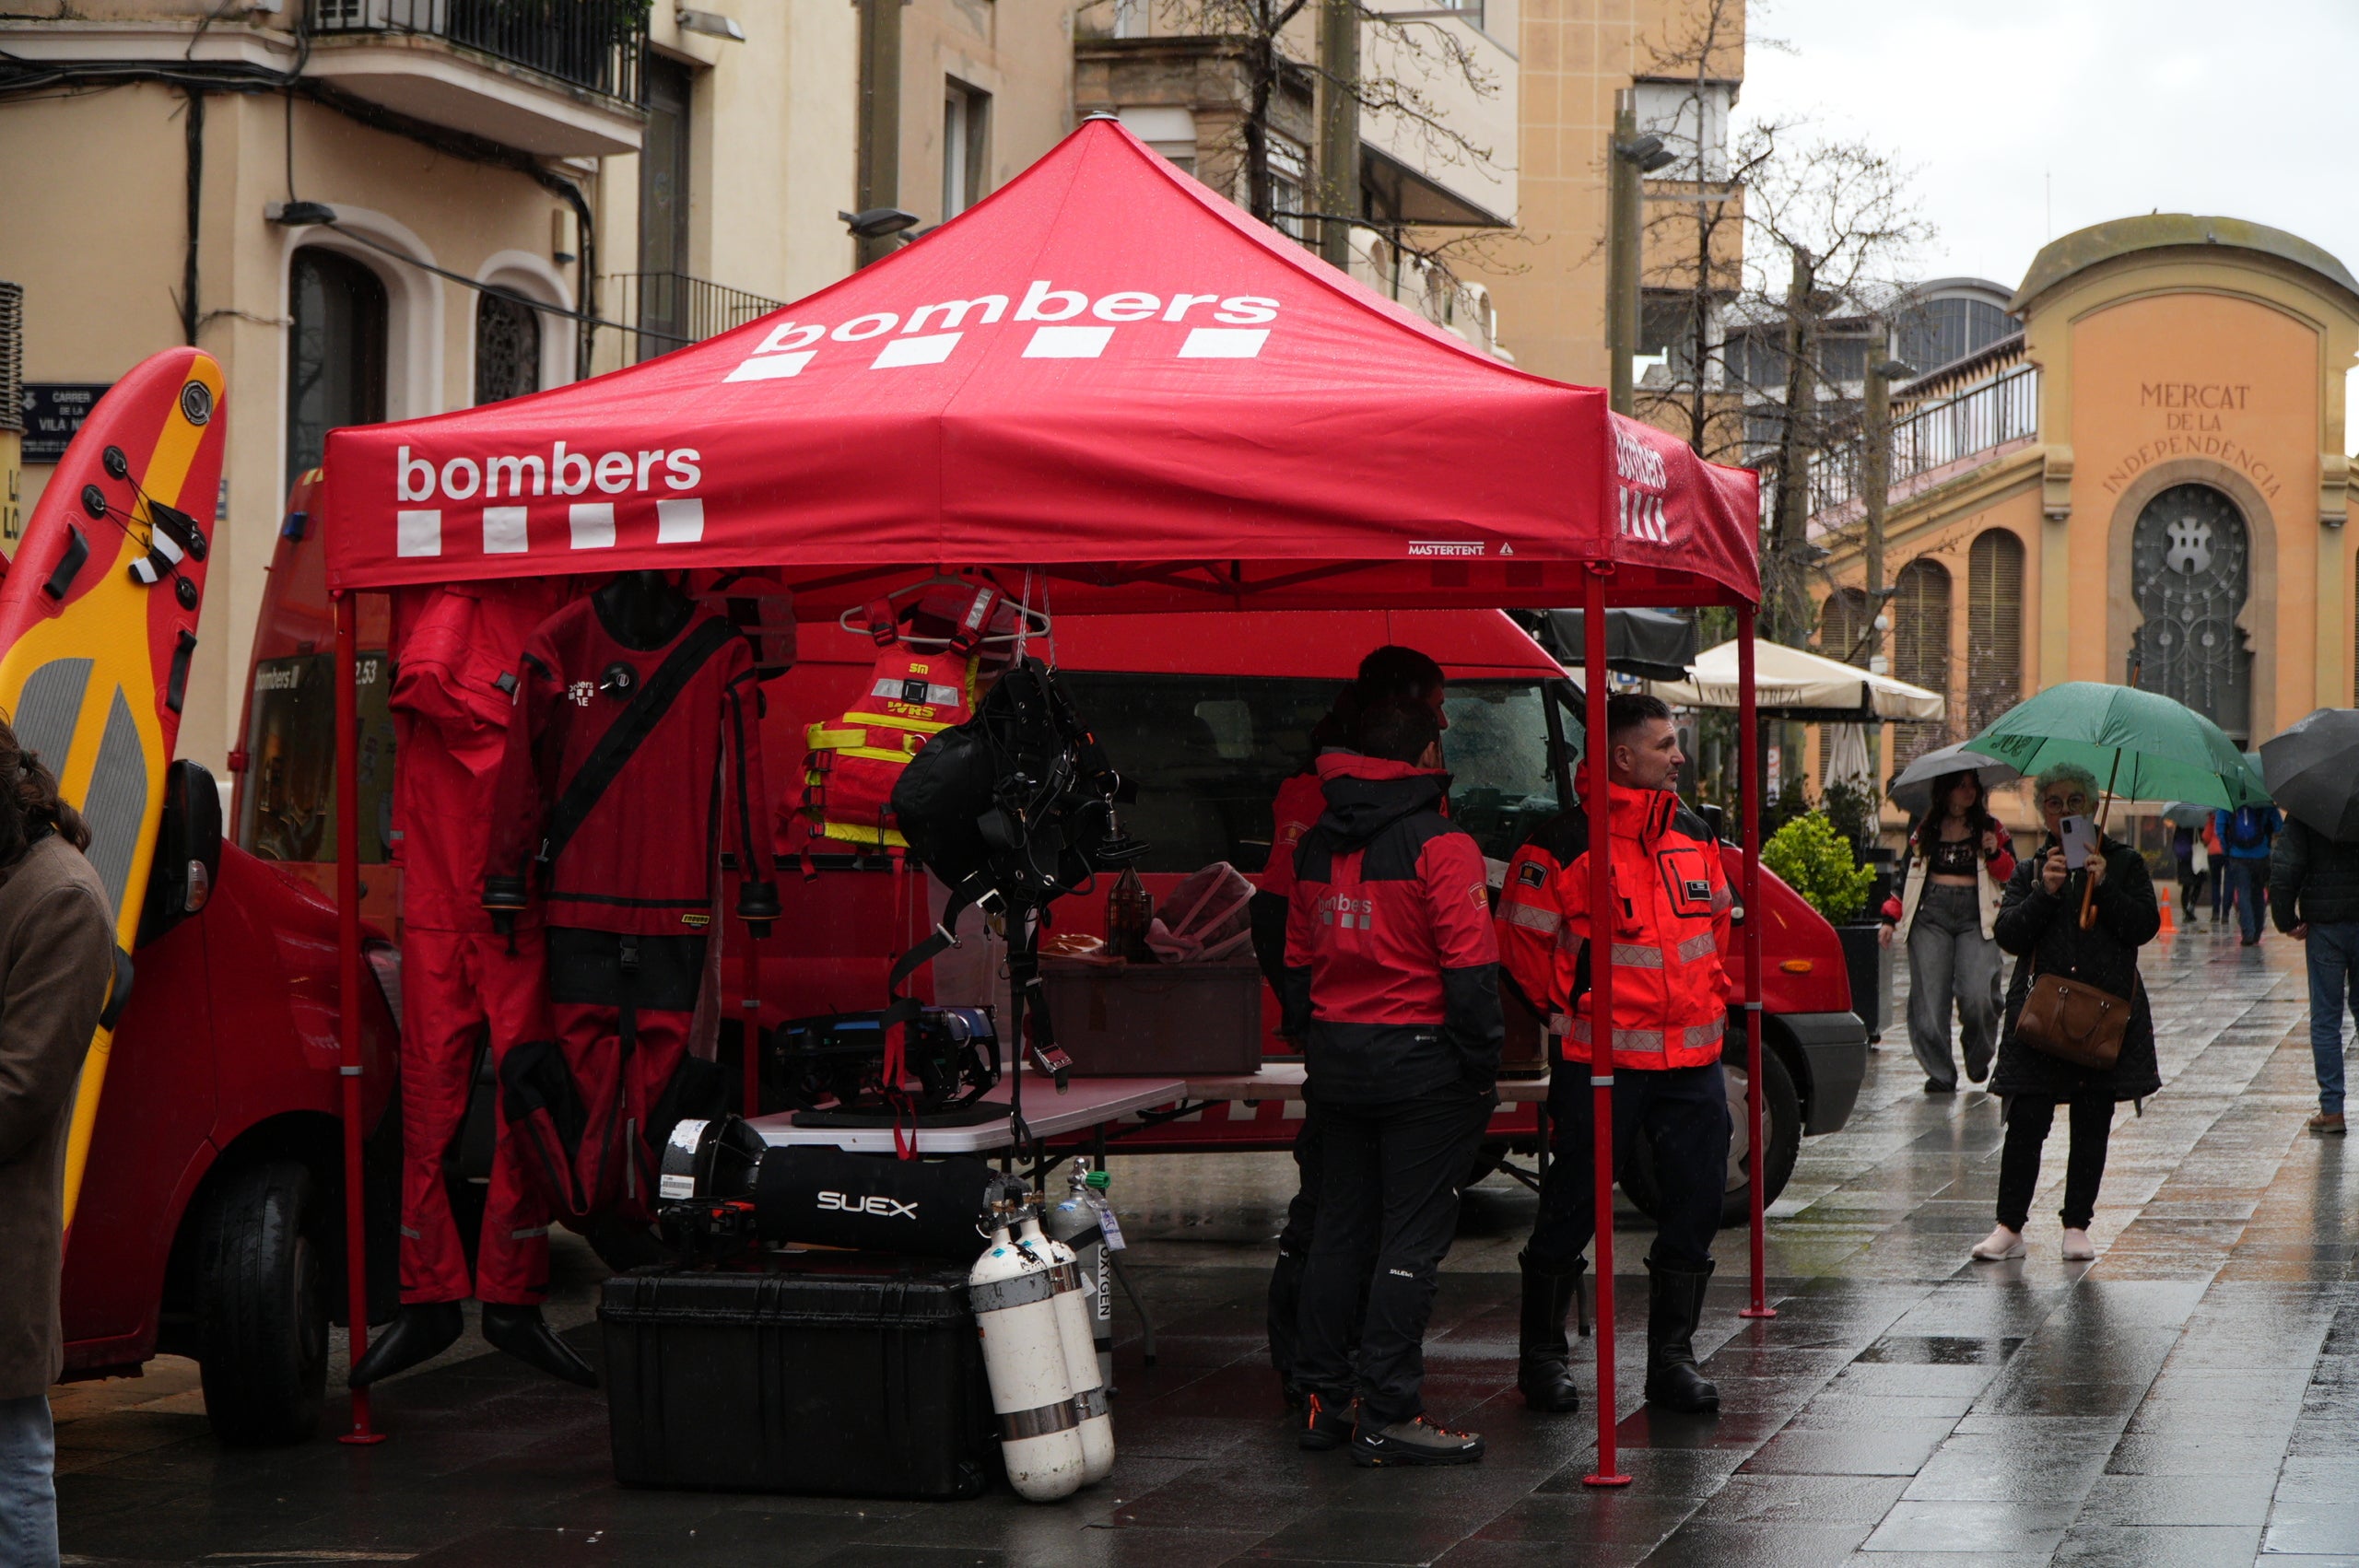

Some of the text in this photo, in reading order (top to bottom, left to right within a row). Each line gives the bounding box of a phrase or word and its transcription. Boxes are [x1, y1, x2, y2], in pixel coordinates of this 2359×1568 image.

[752, 279, 1281, 355] bombers
[52, 391, 90, 404] CARRER
[2141, 382, 2251, 410] MERCAT
[39, 418, 66, 431] VILA
[2167, 413, 2222, 432] DE LA
[397, 440, 702, 501] bombers
[255, 667, 291, 690] bombers
[816, 1190, 919, 1221] SUEX
[1099, 1246, 1110, 1316] OXYGEN
